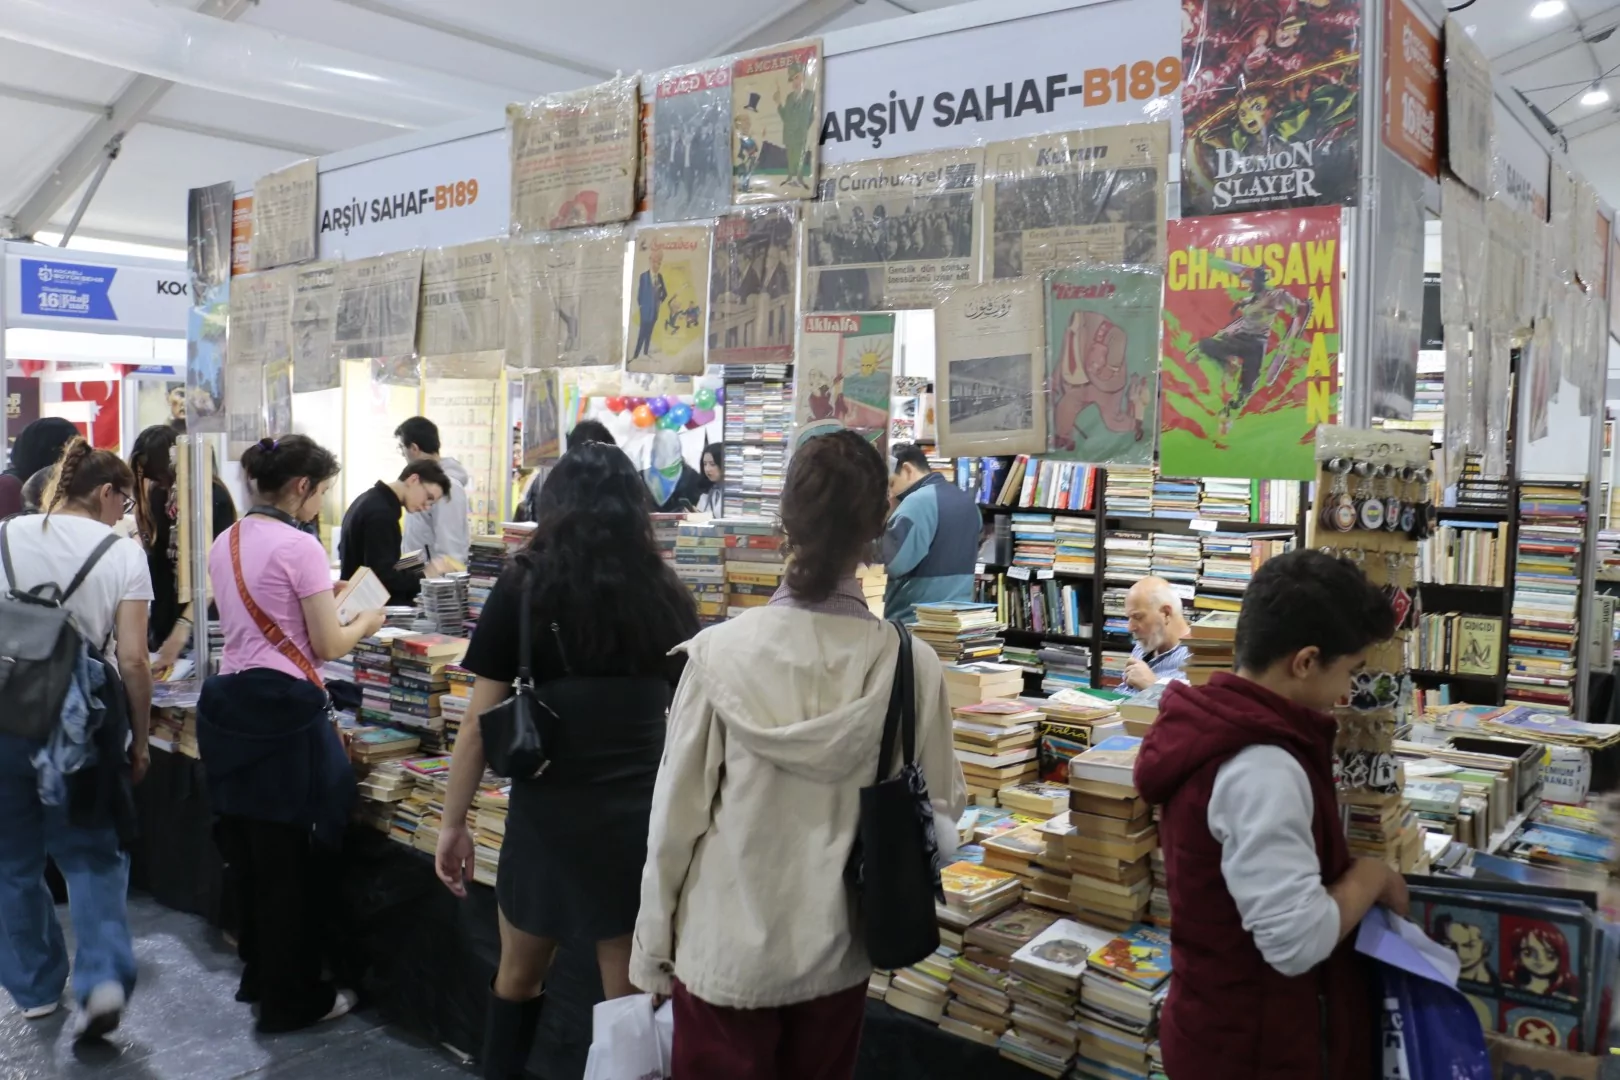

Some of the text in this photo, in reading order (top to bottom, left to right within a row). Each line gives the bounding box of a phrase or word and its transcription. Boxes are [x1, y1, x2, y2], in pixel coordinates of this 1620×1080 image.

[819, 56, 1182, 148] ARŞİV SAHAF-B189
[1214, 138, 1317, 179] DEMON
[320, 197, 368, 236] ARŞİV
[371, 178, 479, 223] SAHAF-B189
[1211, 168, 1323, 211] SLAYER
[1168, 240, 1336, 291] CHAINSAW
[38, 292, 58, 308] 16
[1306, 285, 1334, 424] MAN
[1041, 723, 1088, 739] Julia
